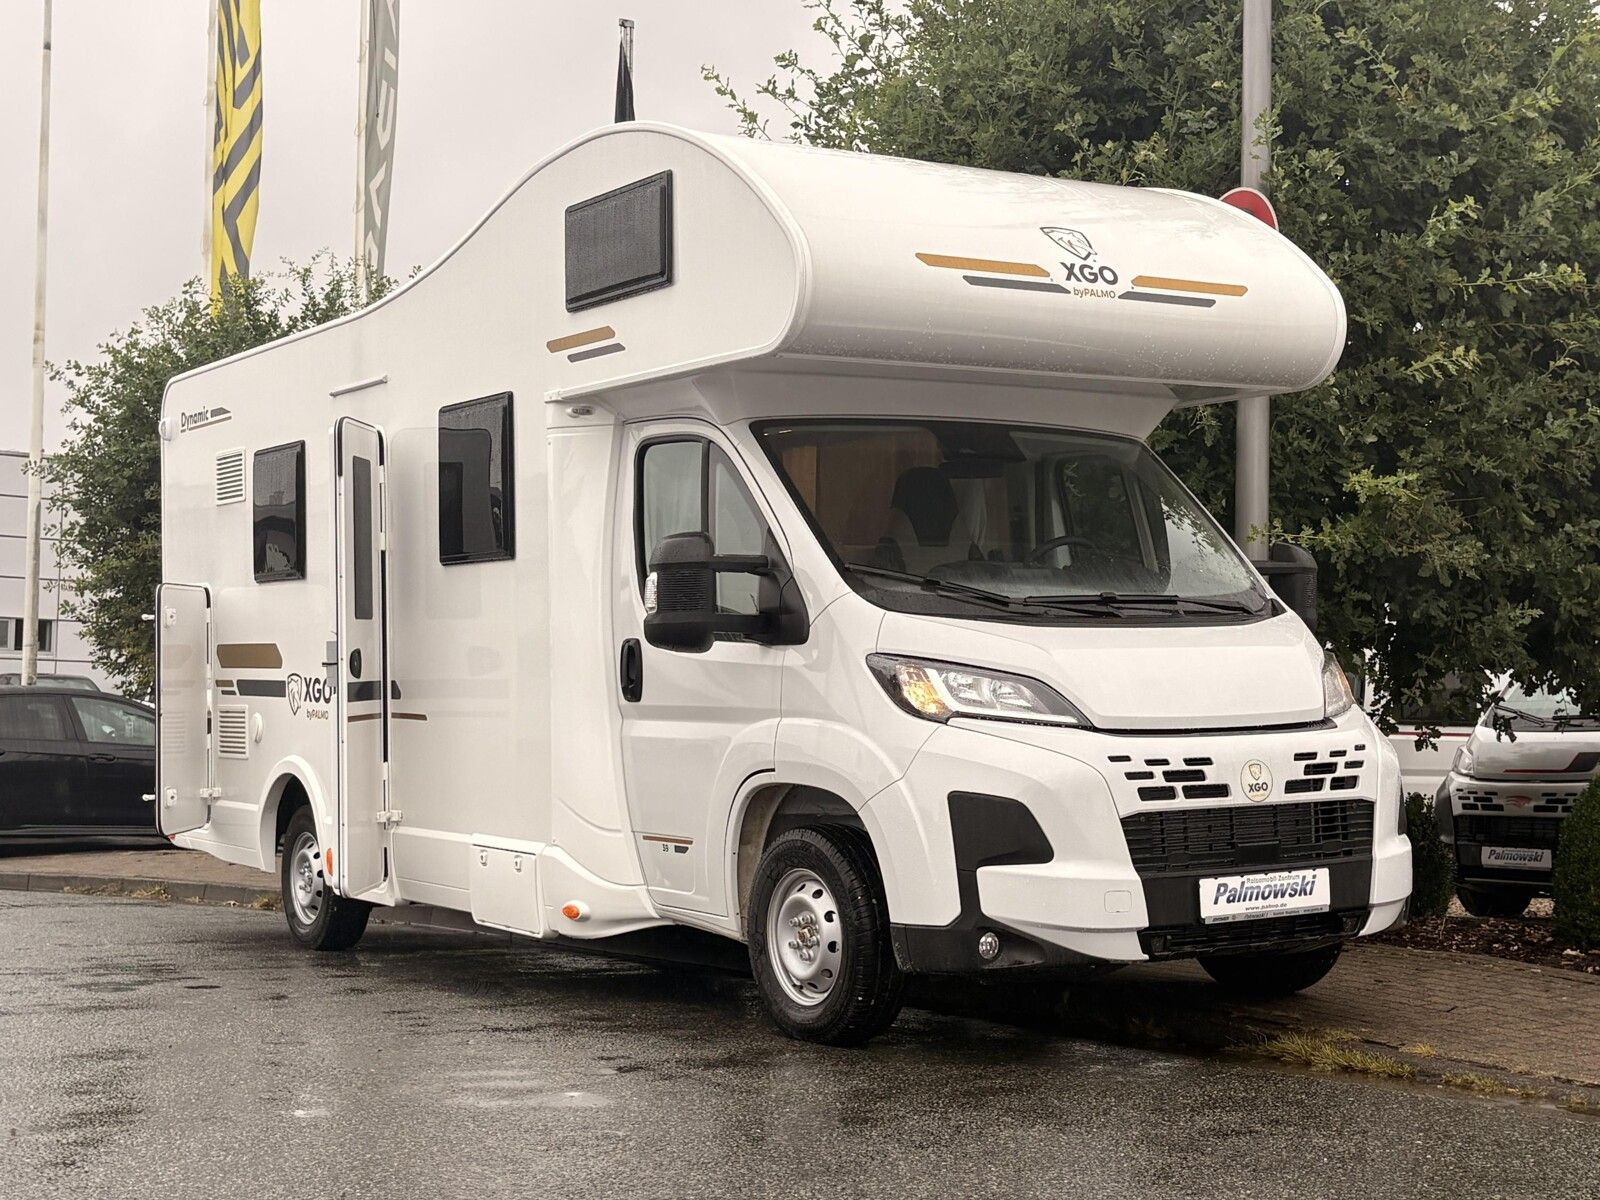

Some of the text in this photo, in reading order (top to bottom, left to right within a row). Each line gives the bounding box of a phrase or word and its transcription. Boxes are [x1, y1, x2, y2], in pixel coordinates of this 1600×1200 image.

[1060, 261, 1119, 286] XGO
[1073, 286, 1116, 299] byPALMO
[180, 406, 209, 430] Dynamic
[303, 677, 332, 704] XGO
[1247, 781, 1269, 794] XGO
[1488, 849, 1544, 862] Palmowski
[1213, 874, 1317, 905] Palmowski
